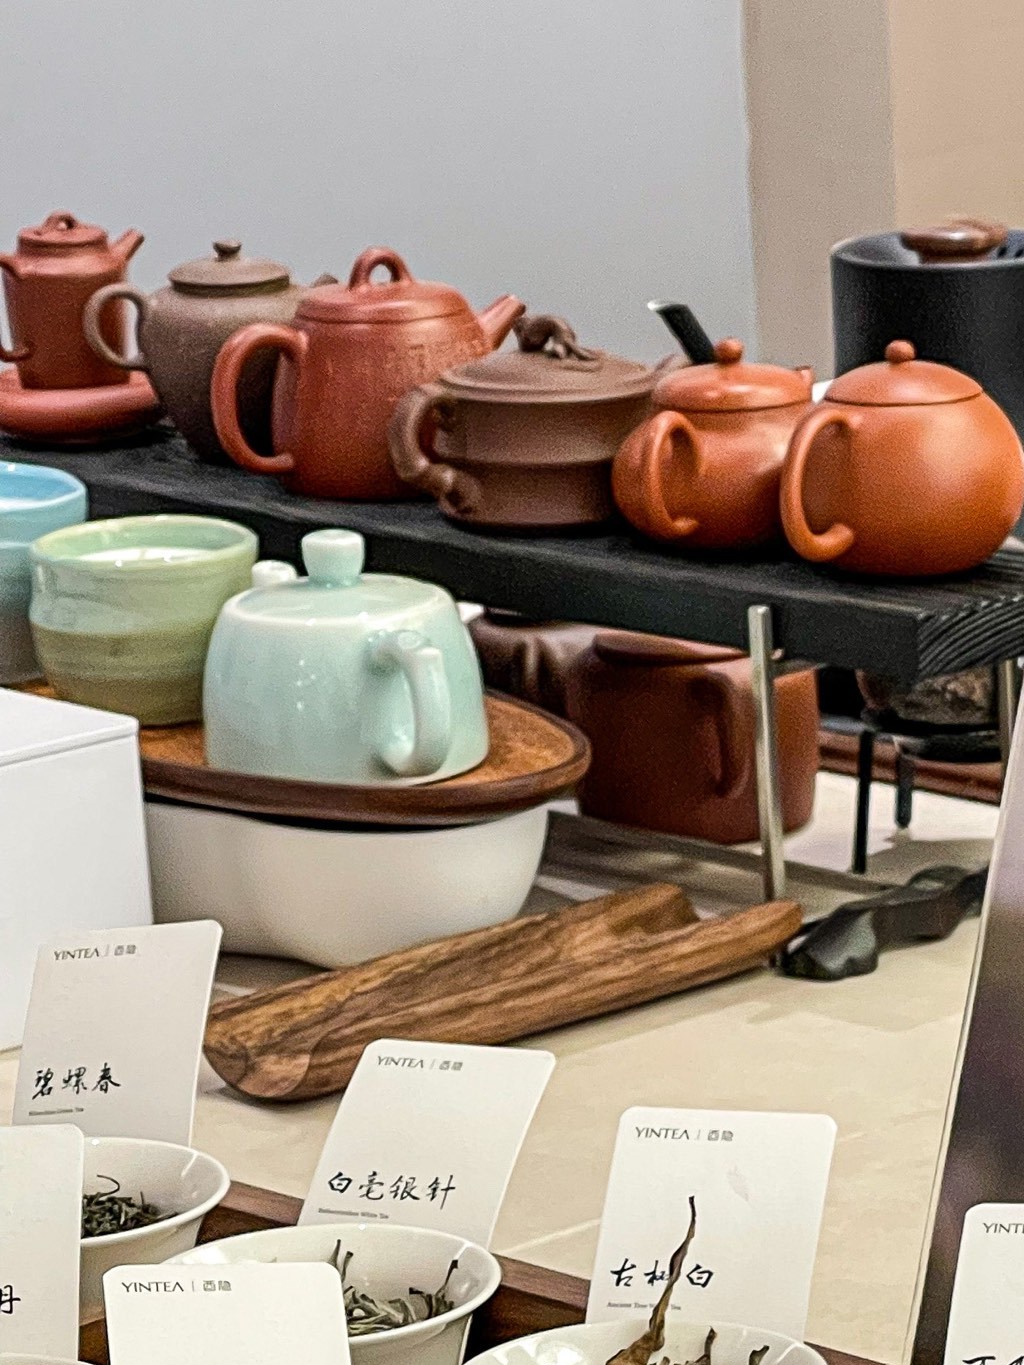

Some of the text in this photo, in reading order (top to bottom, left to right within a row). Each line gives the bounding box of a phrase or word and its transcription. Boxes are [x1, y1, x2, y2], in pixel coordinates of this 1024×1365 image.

[377, 1055, 425, 1070] YINTEA
[32, 1062, 121, 1100] 碧螺春
[635, 1126, 690, 1141] YINTEA
[327, 1171, 457, 1211] 白毫银针
[121, 1280, 184, 1293] YINTEA
